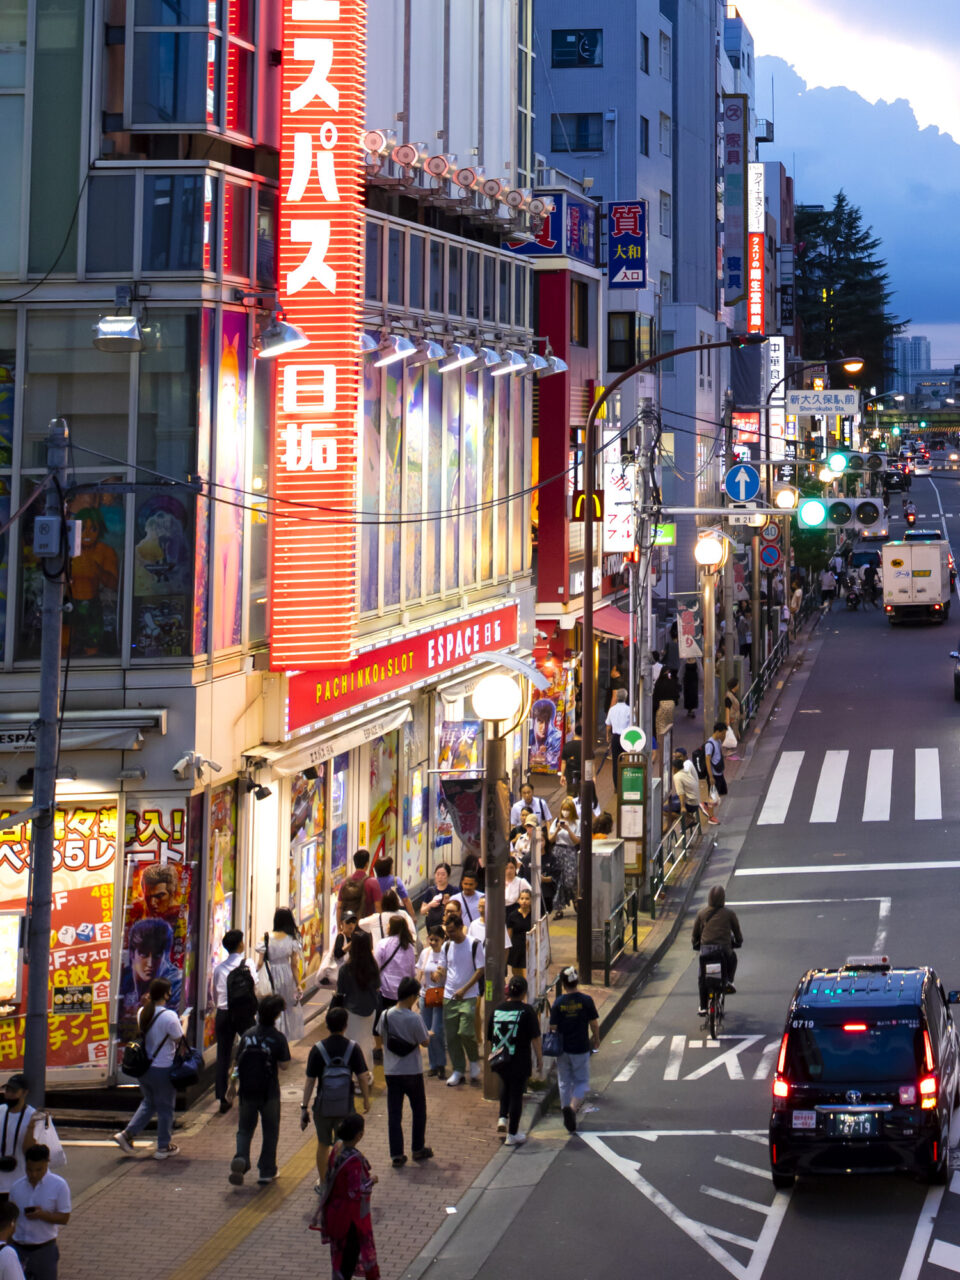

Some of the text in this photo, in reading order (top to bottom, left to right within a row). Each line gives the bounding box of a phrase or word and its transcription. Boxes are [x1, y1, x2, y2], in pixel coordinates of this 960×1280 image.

[726, 133, 741, 165] 家具
[611, 205, 643, 237] 質
[613, 244, 641, 259] 大和
[621, 271, 640, 280] 入口
[790, 394, 855, 405] 新大久保駅前
[280, 364, 338, 471] 日拓
[764, 526, 777, 538] 40
[428, 624, 480, 669] ESPACE
[91, 884, 114, 899] 46
[48, 960, 111, 991] 6枚ス
[792, 1020, 814, 1029] 6719
[843, 1122, 871, 1134] 67-19
